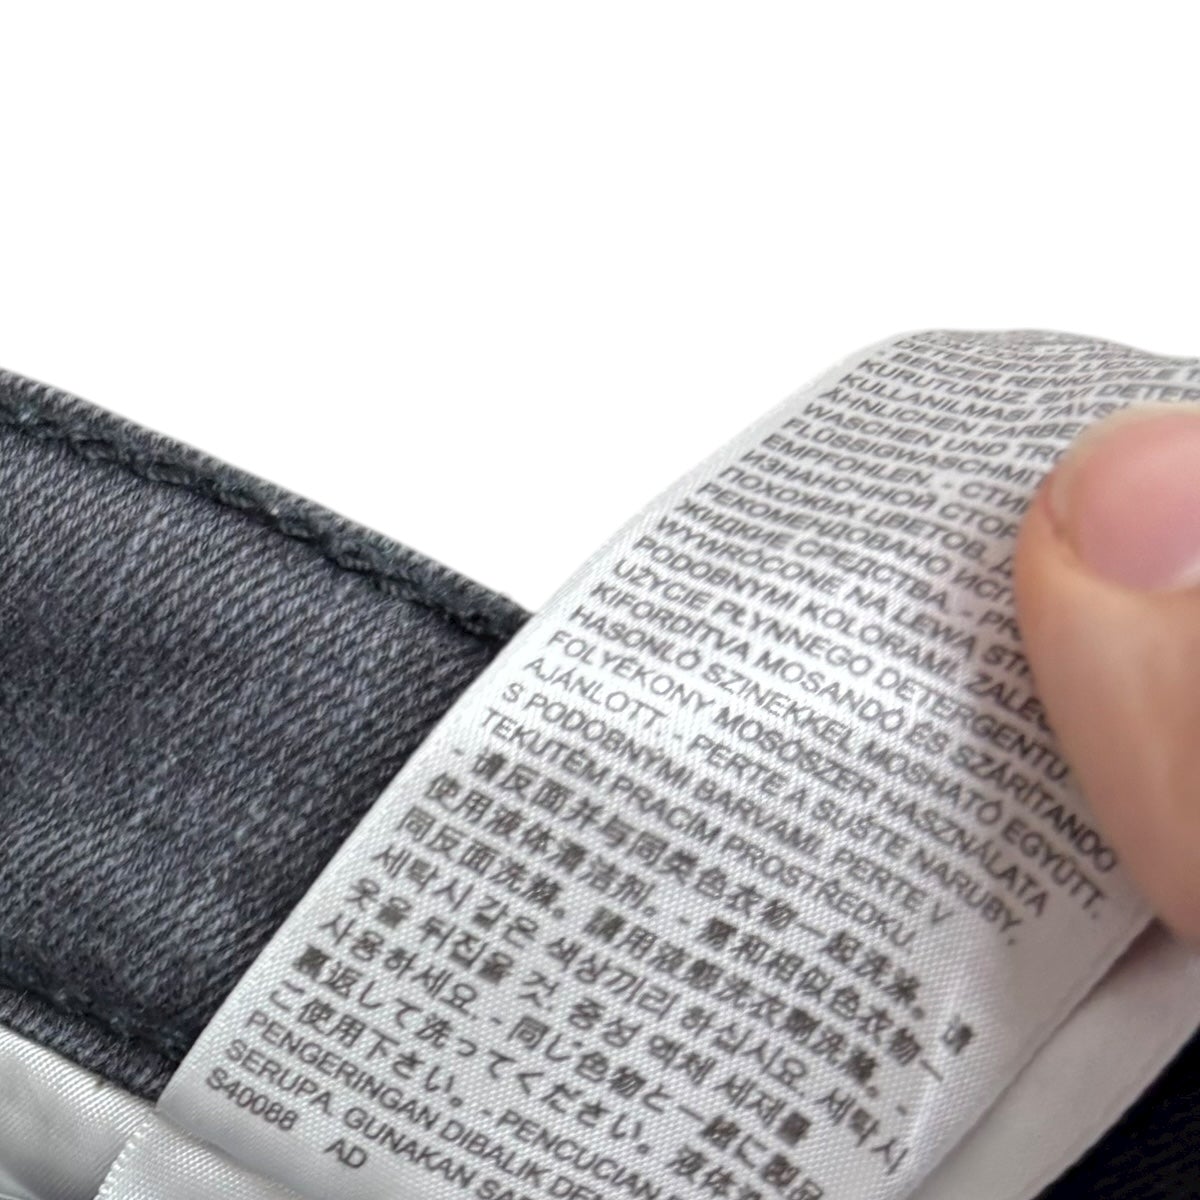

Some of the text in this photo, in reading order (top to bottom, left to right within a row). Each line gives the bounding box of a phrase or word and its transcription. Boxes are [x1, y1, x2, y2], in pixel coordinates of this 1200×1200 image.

[802, 402, 941, 447] WASCHEN
[942, 438, 1009, 457] UND
[631, 535, 800, 612] PODOBNYMI
[844, 583, 887, 616] NA
[546, 629, 715, 716] FOLYÉKONY
[479, 705, 612, 788] TEKUTÉM
[686, 732, 789, 799] PERTE
[783, 786, 809, 810] A
[500, 679, 526, 704] S
[829, 845, 928, 914] PERTE
[928, 902, 954, 926] V
[202, 1065, 367, 1171] S40088 AD
[243, 1010, 441, 1131] PENGERINGAN
[438, 1118, 551, 1187] DIBALIK
[339, 1104, 477, 1190] GUNAKAN
